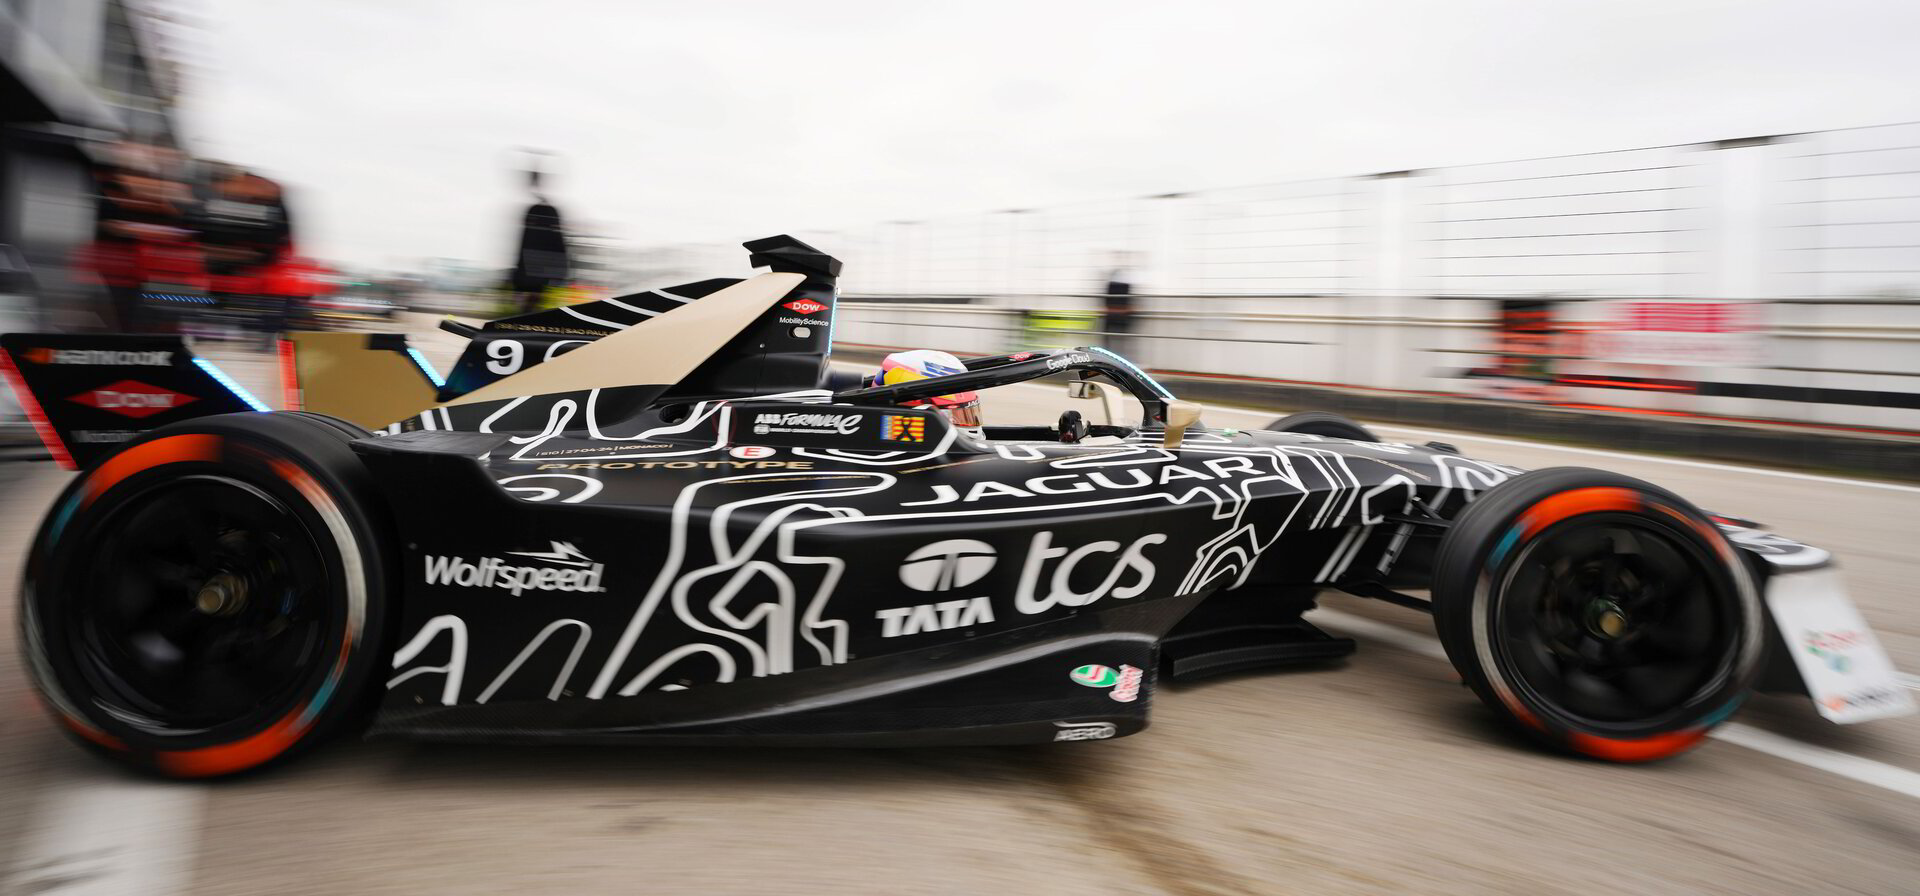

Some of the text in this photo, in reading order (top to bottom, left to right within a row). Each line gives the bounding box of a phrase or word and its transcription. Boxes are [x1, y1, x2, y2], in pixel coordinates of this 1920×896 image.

[793, 302, 820, 311] DOW
[779, 316, 829, 327] MobilityScience
[485, 339, 524, 375] 9
[1046, 353, 1090, 370] Google Cloud
[94, 390, 176, 408] DOW
[754, 413, 781, 424] ABB
[743, 447, 762, 457] E
[536, 461, 814, 470] PROTOTYPE
[899, 456, 1267, 507] JAGUAR
[425, 554, 606, 597] Wolfspeed
[1014, 530, 1168, 615] tcs
[875, 596, 995, 638] TATA
